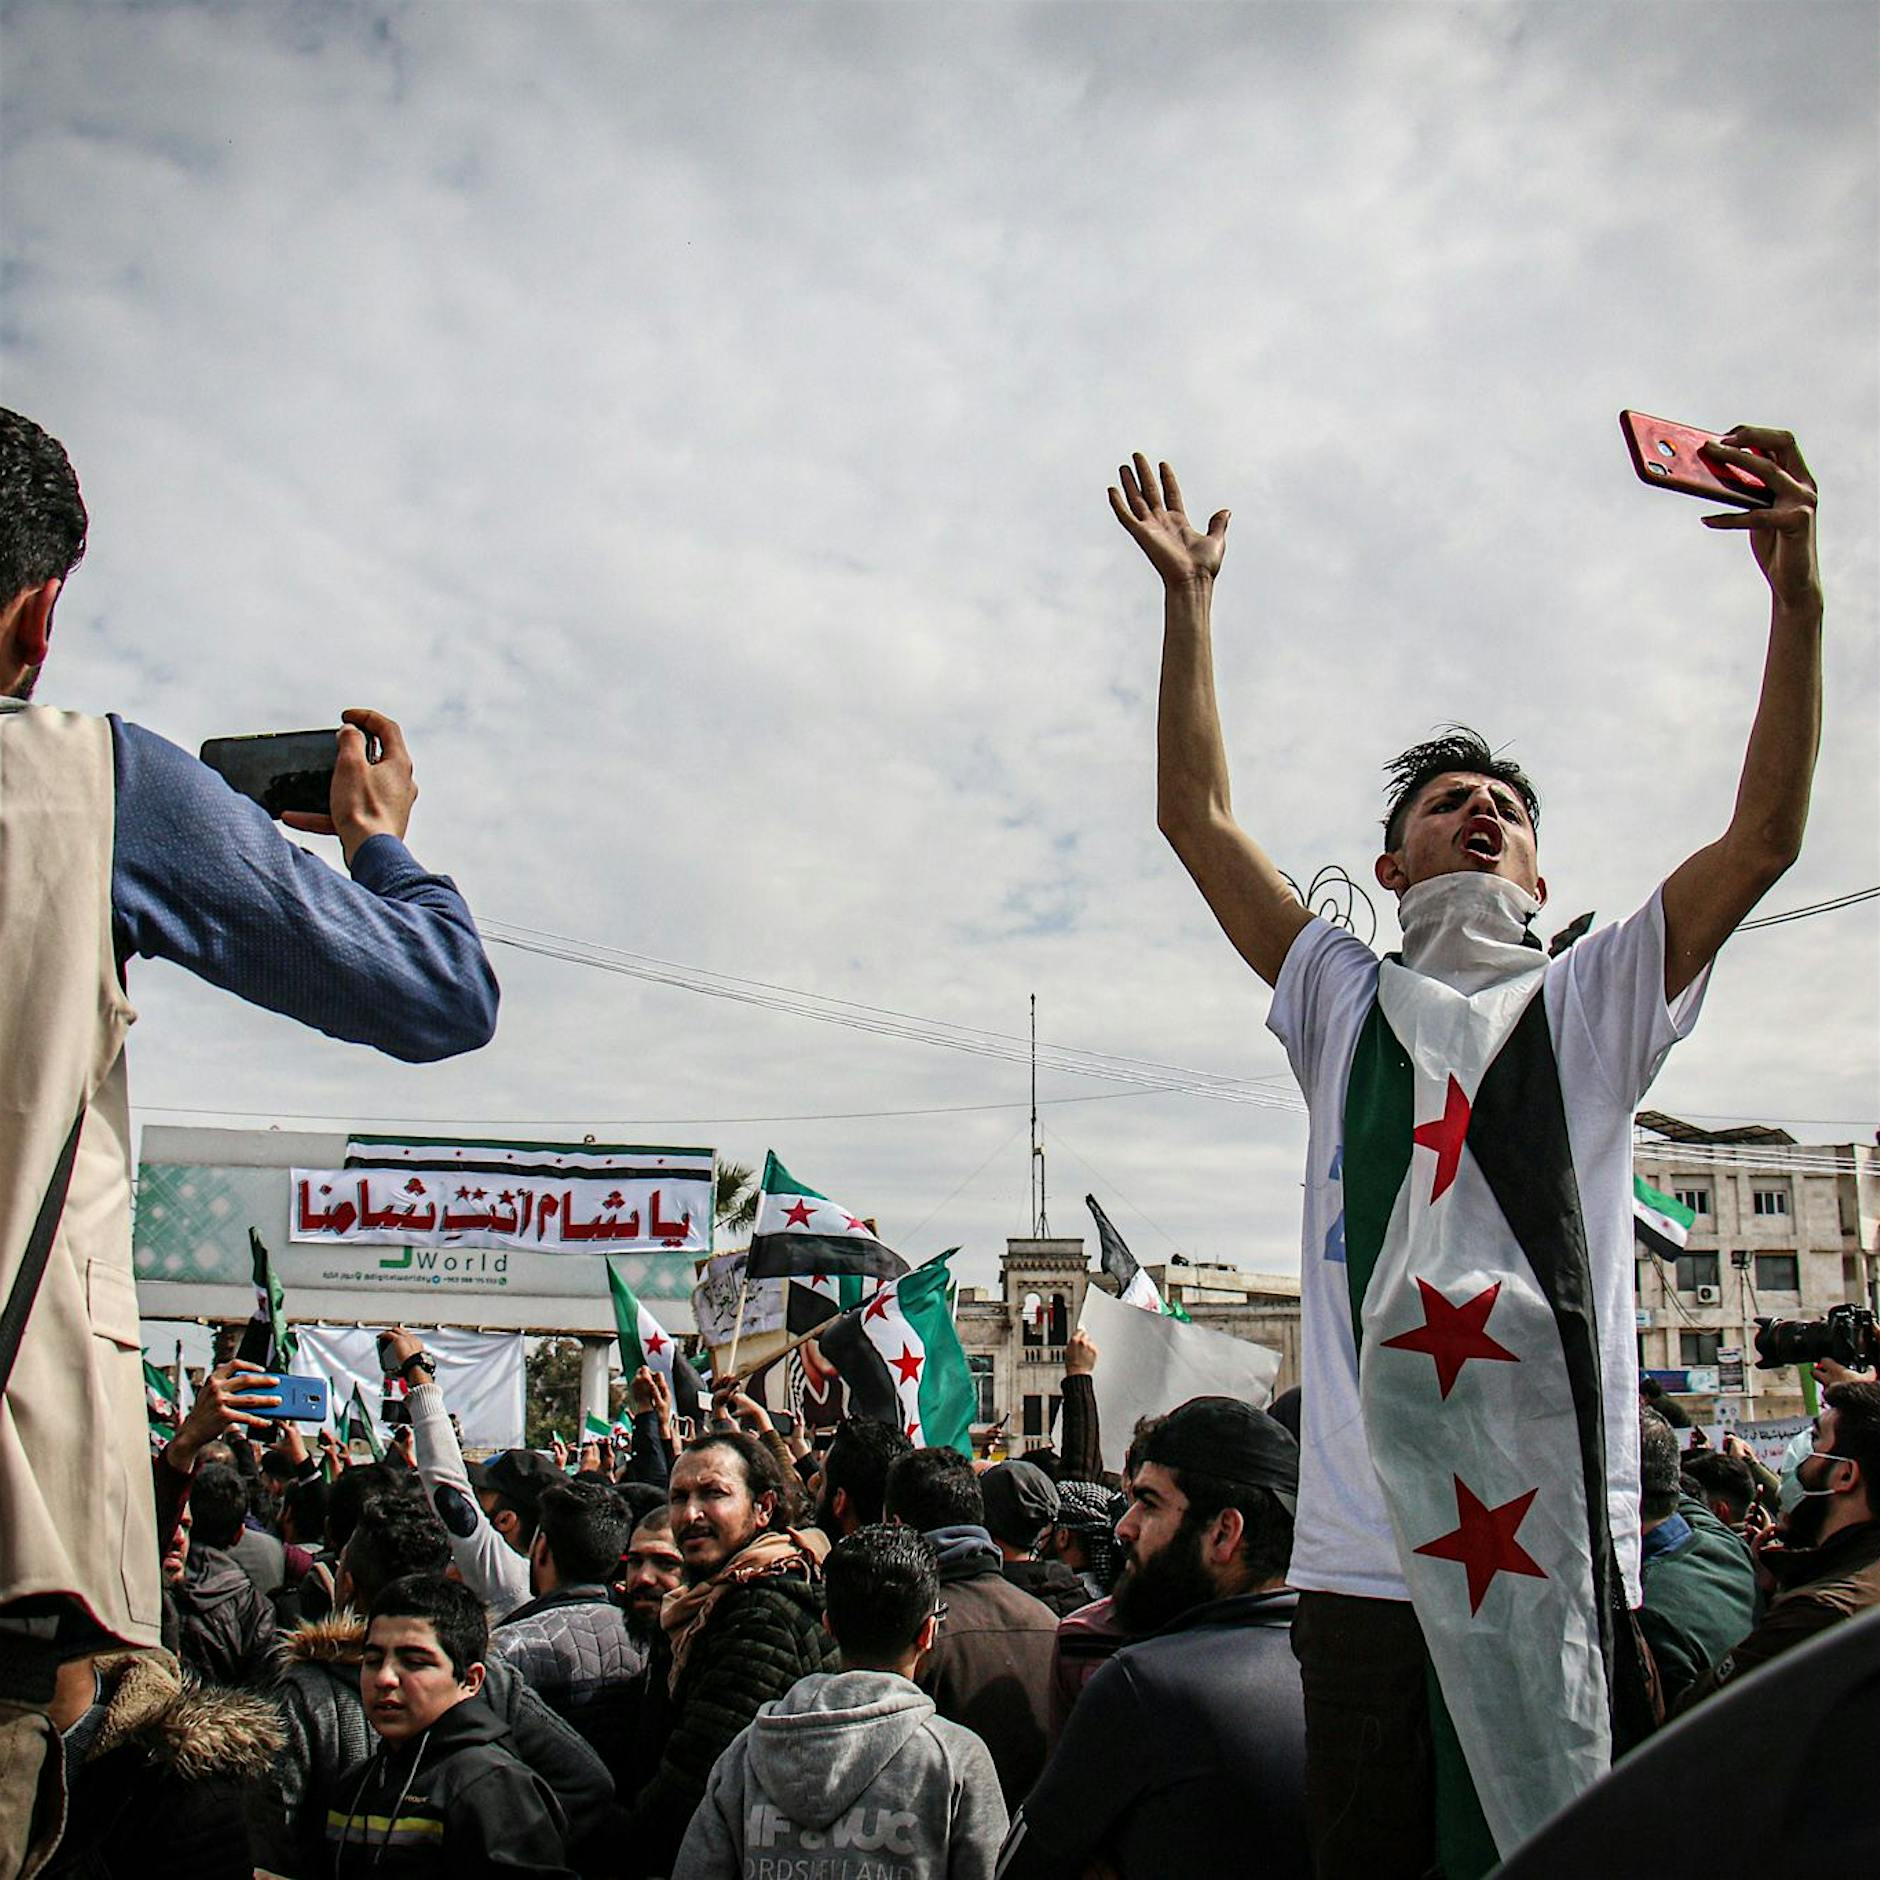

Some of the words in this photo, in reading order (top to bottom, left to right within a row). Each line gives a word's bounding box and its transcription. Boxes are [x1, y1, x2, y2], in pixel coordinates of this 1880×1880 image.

[298, 1178, 436, 1235] شامنا
[537, 1190, 640, 1242] شام
[649, 1190, 690, 1247] يا
[416, 1252, 508, 1272] World
